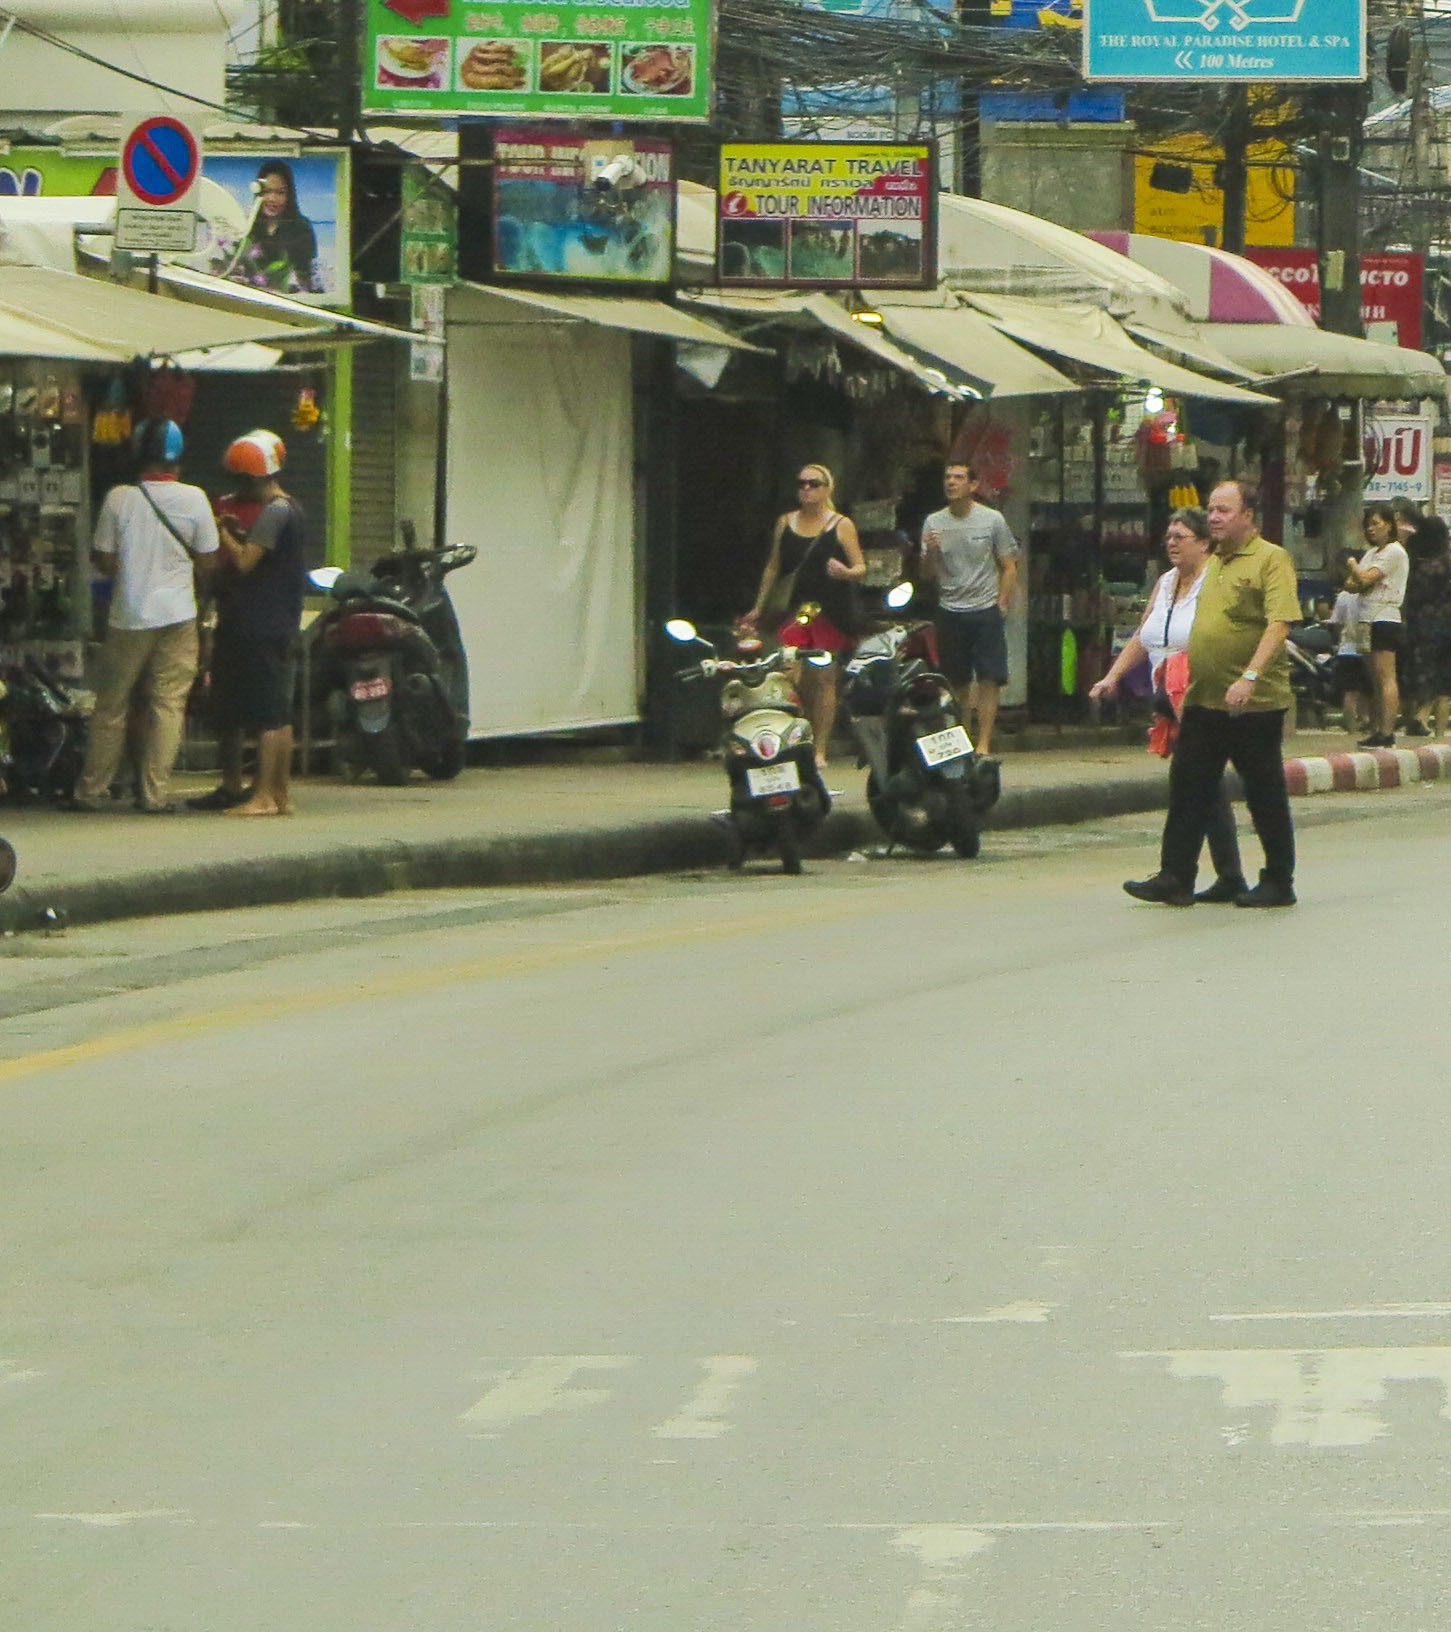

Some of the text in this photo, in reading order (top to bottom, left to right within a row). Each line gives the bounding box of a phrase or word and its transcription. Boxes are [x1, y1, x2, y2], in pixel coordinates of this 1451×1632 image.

[1099, 34, 1350, 48] THE ROYAL PARADISE HOTEL & SPA
[1199, 53, 1275, 69] 100 Metres
[725, 157, 924, 177] TANYARAT TRAVEL
[757, 194, 921, 218] TOUR INFORMATION
